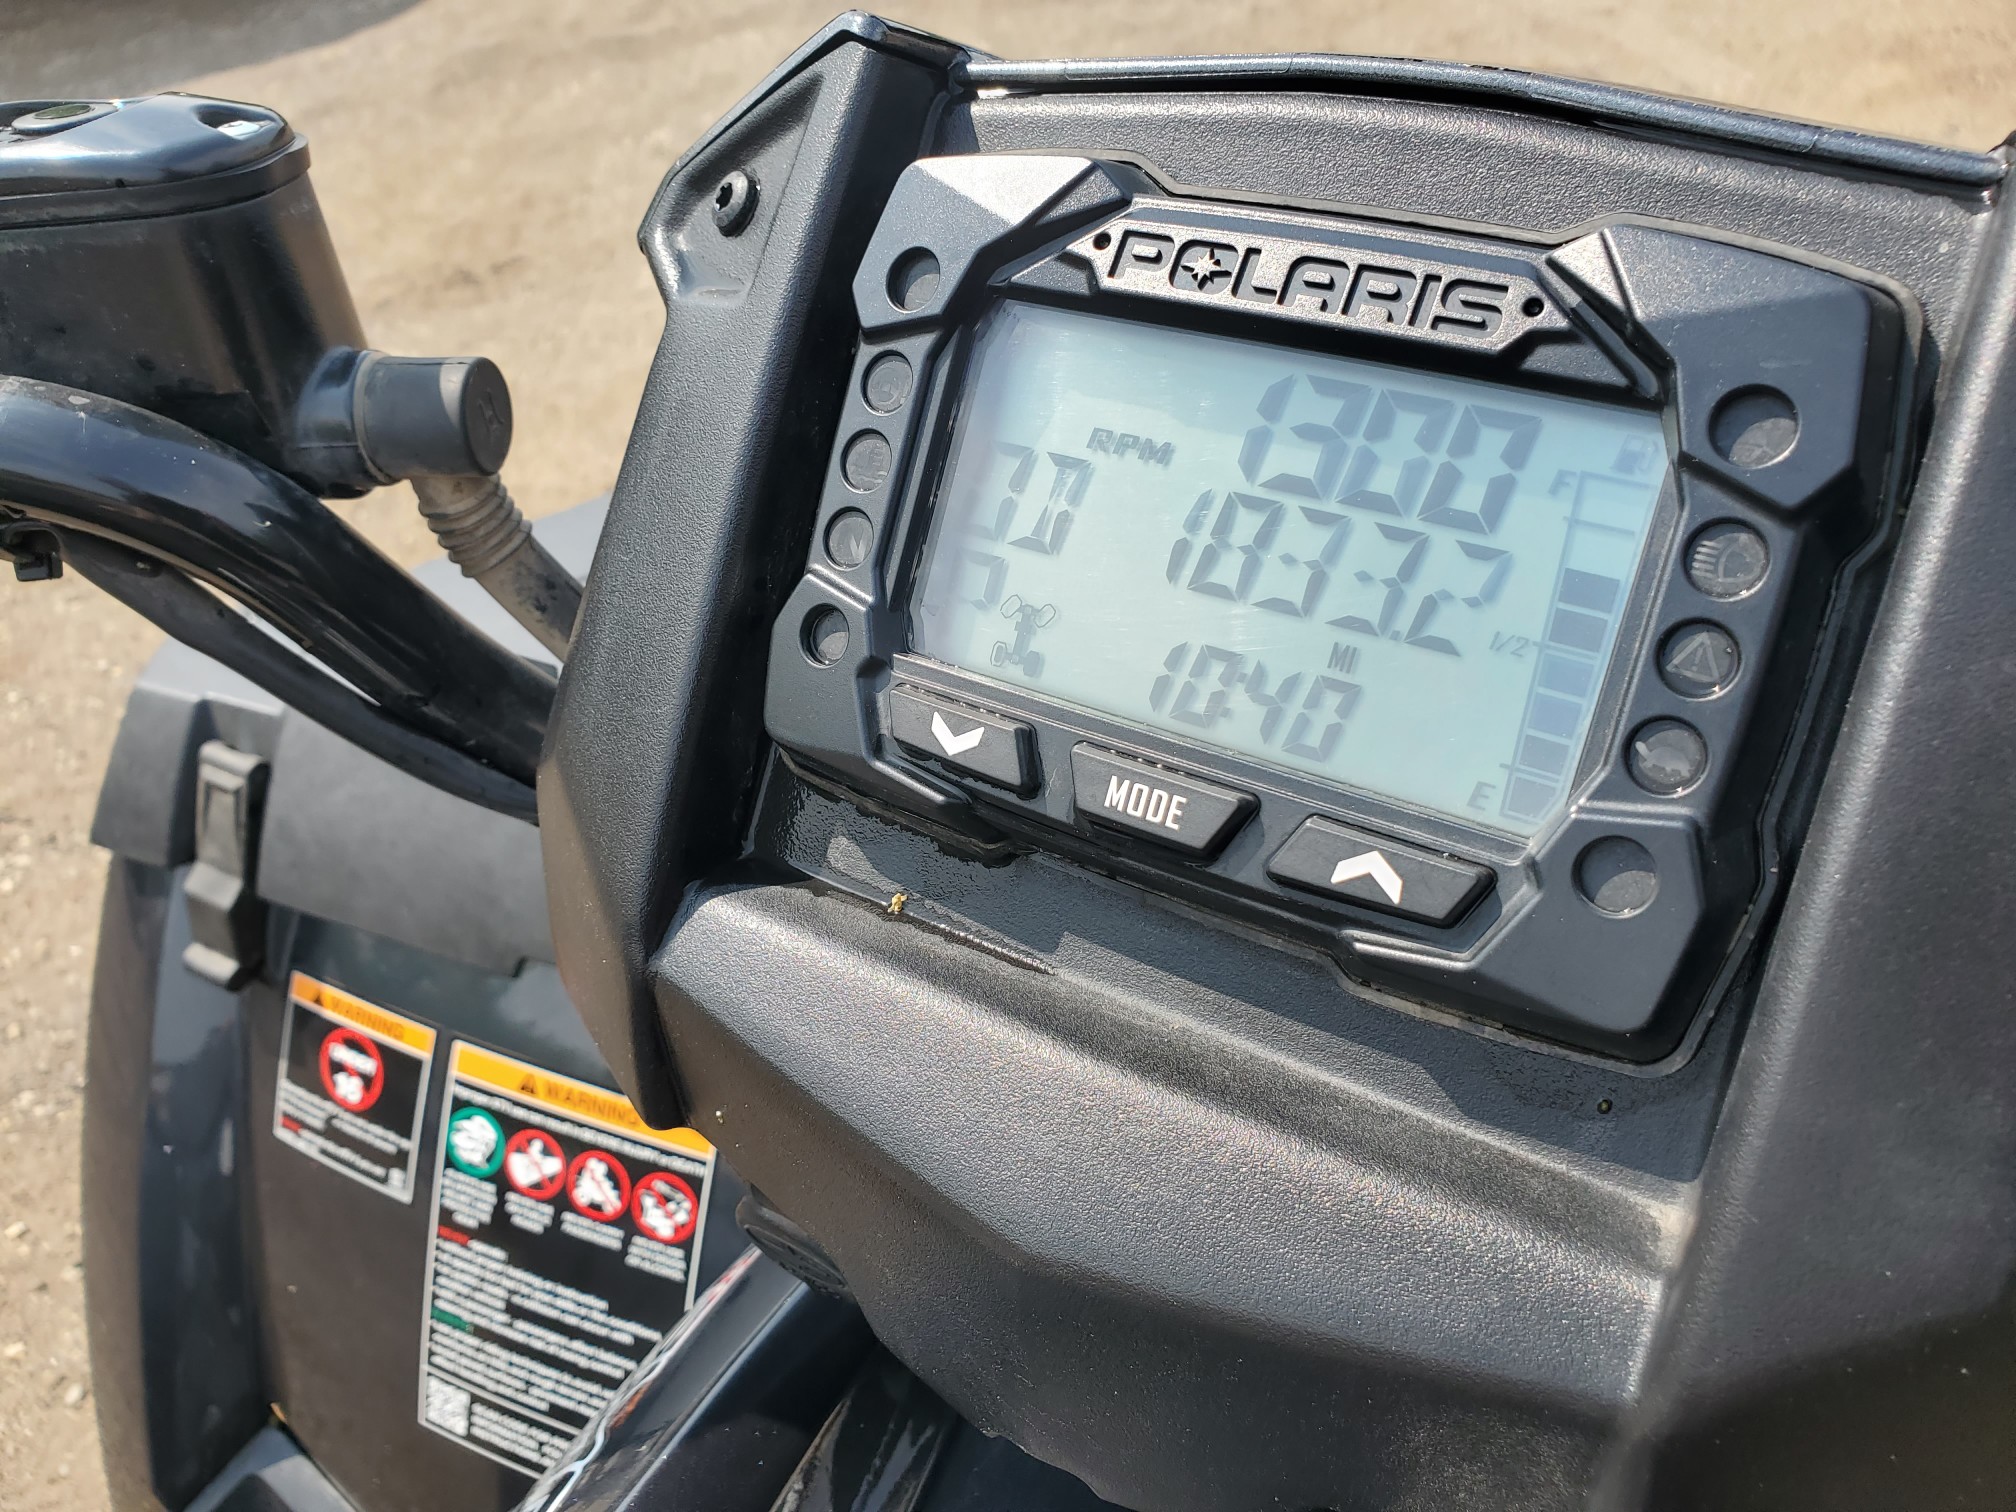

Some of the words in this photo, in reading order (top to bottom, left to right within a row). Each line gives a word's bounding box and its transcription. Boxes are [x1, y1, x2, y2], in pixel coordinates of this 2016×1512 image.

[1108, 229, 1510, 340] POLARIS
[1086, 427, 1174, 466] RPM
[1238, 373, 1542, 536] 1300
[1327, 640, 1358, 675] MI
[1488, 630, 1530, 658] 1/2
[1149, 640, 1362, 764] 10:40
[1103, 775, 1188, 832] MODE
[1470, 780, 1497, 812] E
[544, 1079, 641, 1128] WARNING
